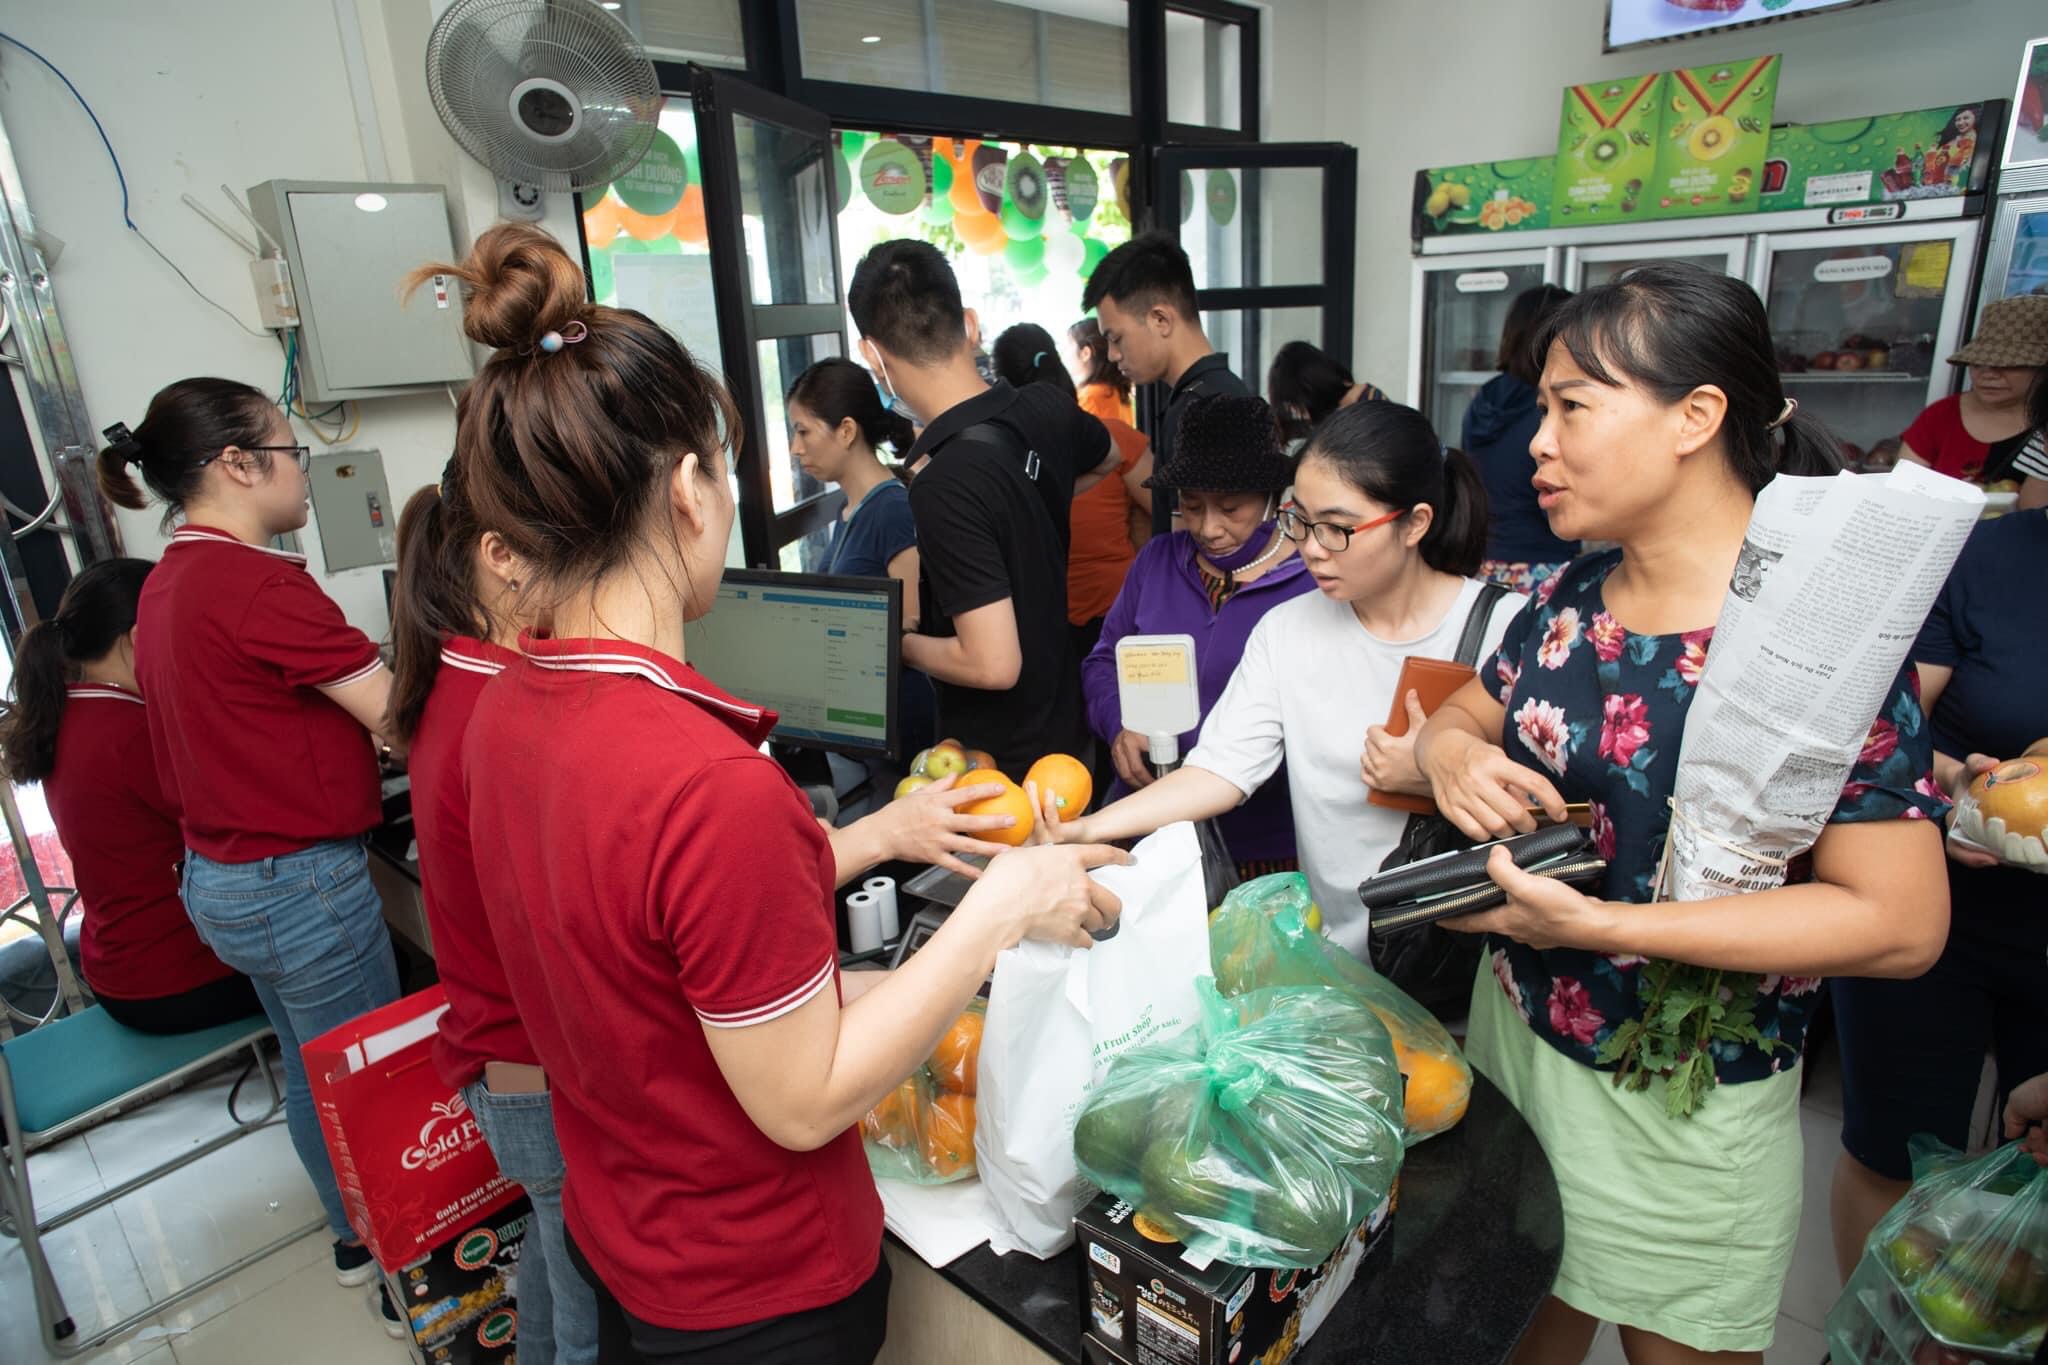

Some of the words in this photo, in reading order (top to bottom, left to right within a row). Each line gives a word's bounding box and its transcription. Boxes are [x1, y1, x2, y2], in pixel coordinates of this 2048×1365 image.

[1103, 1032, 1131, 1050] Fruit
[1132, 1016, 1152, 1037] Shop
[435, 1201, 459, 1221] Gold
[460, 1186, 485, 1206] Fruit
